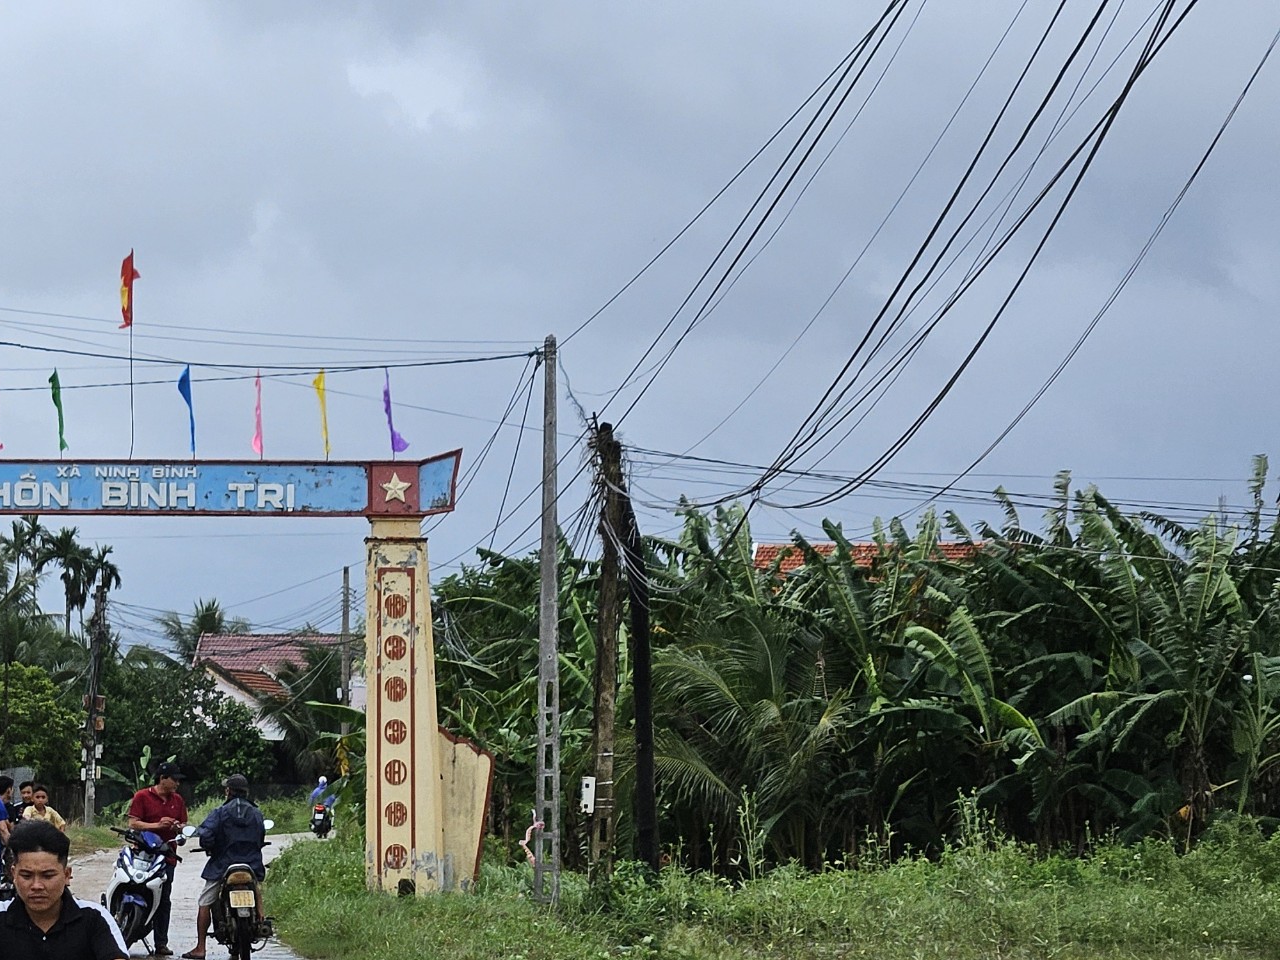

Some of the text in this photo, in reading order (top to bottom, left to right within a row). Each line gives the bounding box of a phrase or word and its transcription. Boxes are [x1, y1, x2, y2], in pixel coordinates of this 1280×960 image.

[57, 463, 81, 478] XÃ
[95, 466, 140, 478] NINH
[228, 483, 295, 511] TRỊ
